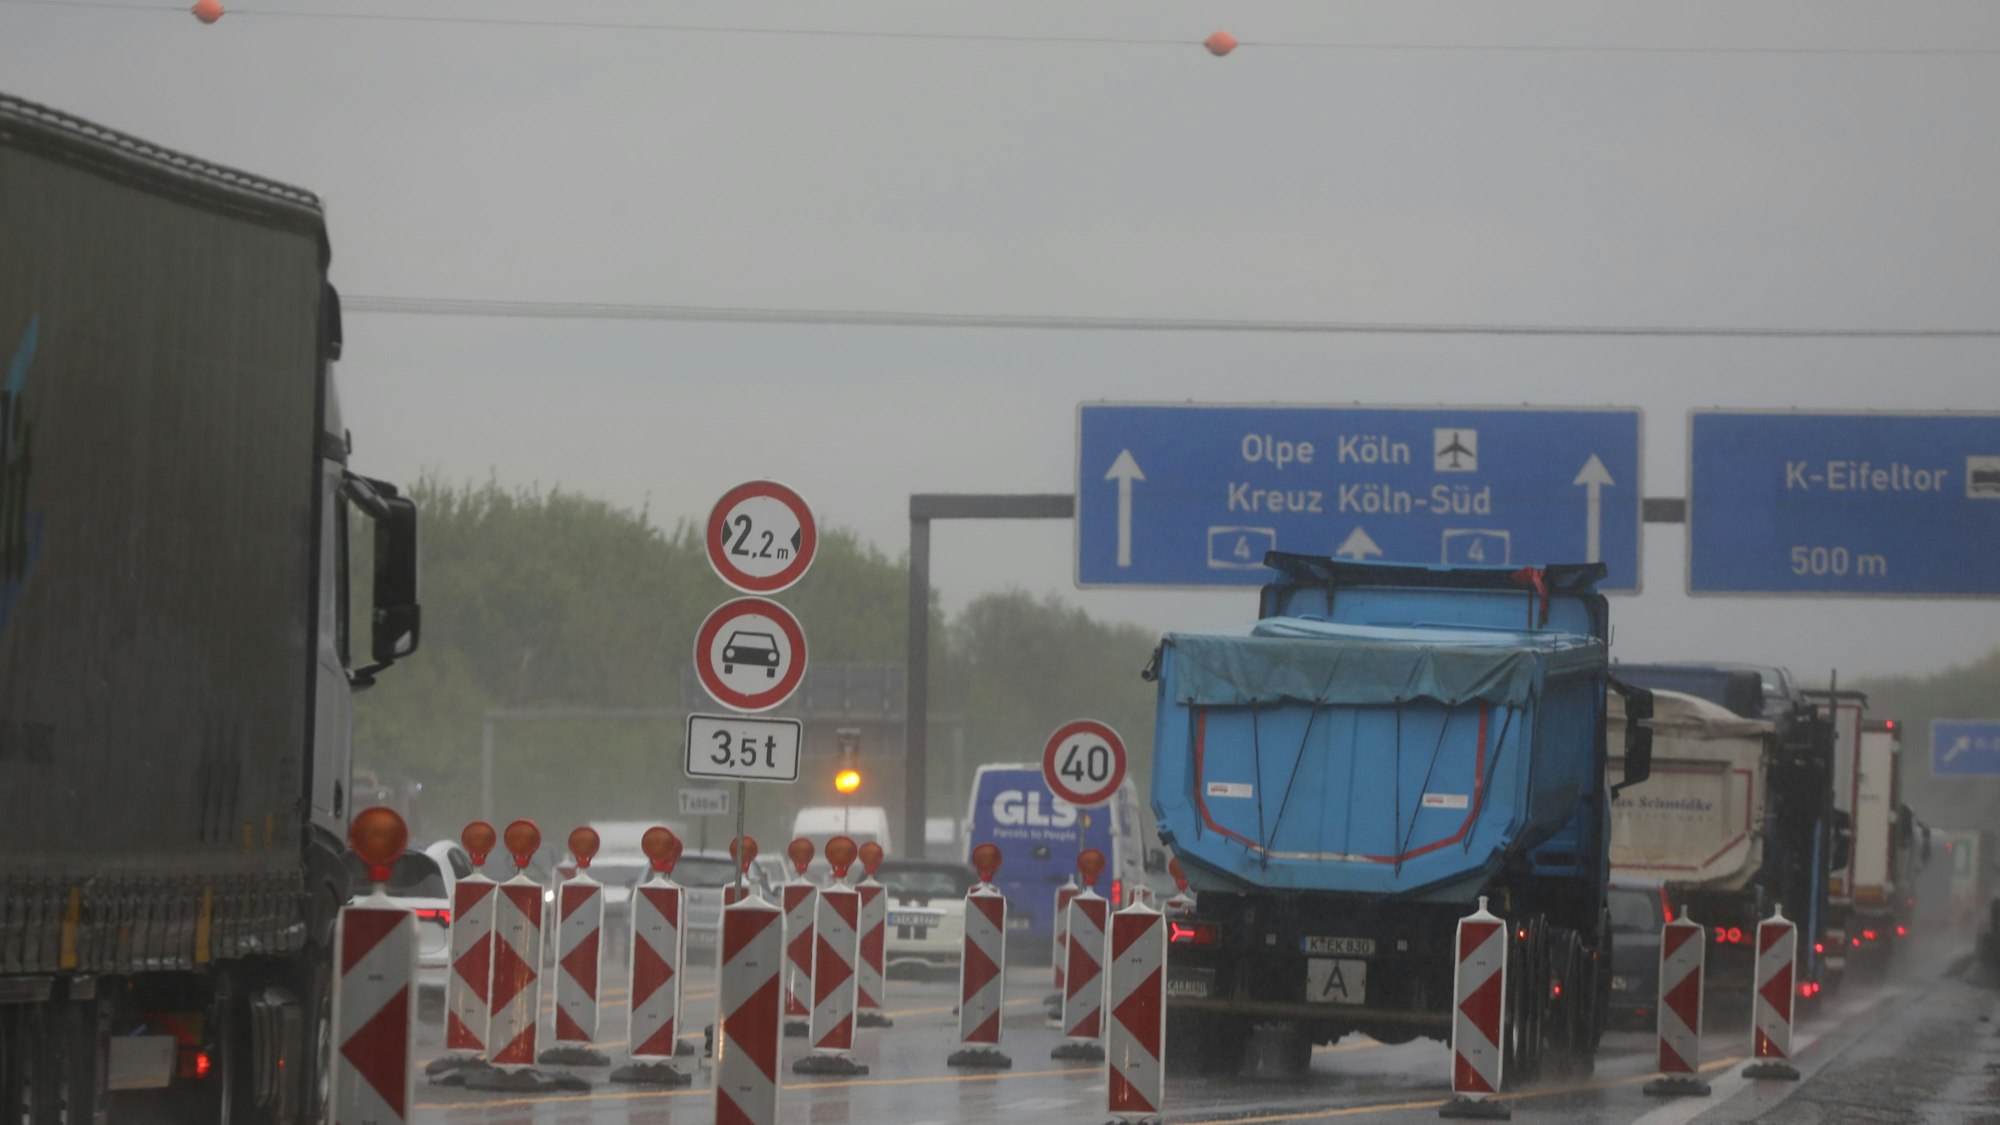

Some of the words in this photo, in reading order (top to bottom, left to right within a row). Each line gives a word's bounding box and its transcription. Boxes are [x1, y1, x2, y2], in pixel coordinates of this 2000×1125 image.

[1241, 434, 1315, 470] Olpe
[1337, 434, 1411, 464] Köln
[1785, 460, 1948, 491] K-Eifeltor
[1227, 482, 1324, 514] Kreuz
[1338, 483, 1491, 516] Köln-Süd
[731, 513, 775, 560] 2,2
[776, 546, 789, 560] m
[1232, 534, 1251, 560] 4
[1466, 537, 1485, 563] 4
[1790, 546, 1850, 576] 500
[1856, 552, 1887, 576] m
[709, 729, 757, 768] 3,5
[764, 735, 777, 768] t
[1061, 744, 1109, 782] 40
[993, 790, 1077, 827] GLS
[1322, 965, 1348, 998] A
